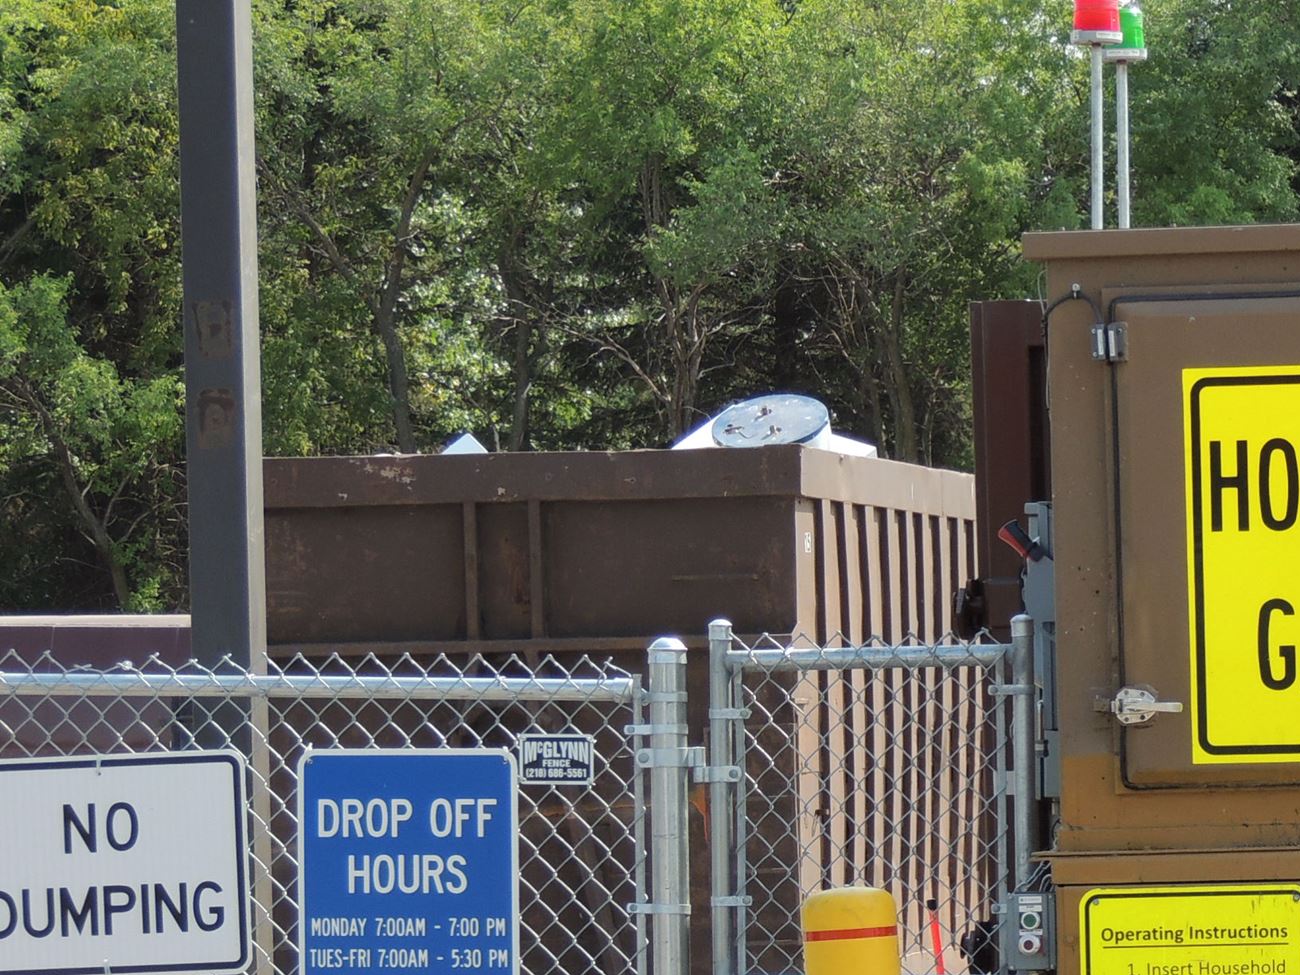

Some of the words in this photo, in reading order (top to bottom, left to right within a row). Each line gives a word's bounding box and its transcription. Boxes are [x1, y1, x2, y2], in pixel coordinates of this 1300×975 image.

[526, 768, 547, 778] (218)
[548, 768, 587, 778] 686-5561
[542, 759, 571, 767] FENCE
[317, 798, 413, 838] DROP
[430, 797, 498, 838] OFF
[62, 801, 140, 855] NO
[348, 854, 468, 894] HOURS
[311, 917, 367, 937] MONDAY
[375, 917, 426, 937] 7:00AM
[449, 917, 479, 937] 7:00
[486, 917, 506, 937] PM
[1101, 927, 1184, 944] Operating
[1189, 924, 1288, 940] Instructions
[310, 948, 371, 968] TUES-FRI
[378, 948, 428, 968] 7:00AM
[451, 948, 481, 968] 5:30
[489, 948, 508, 968] PM
[1199, 960, 1286, 975] Household
